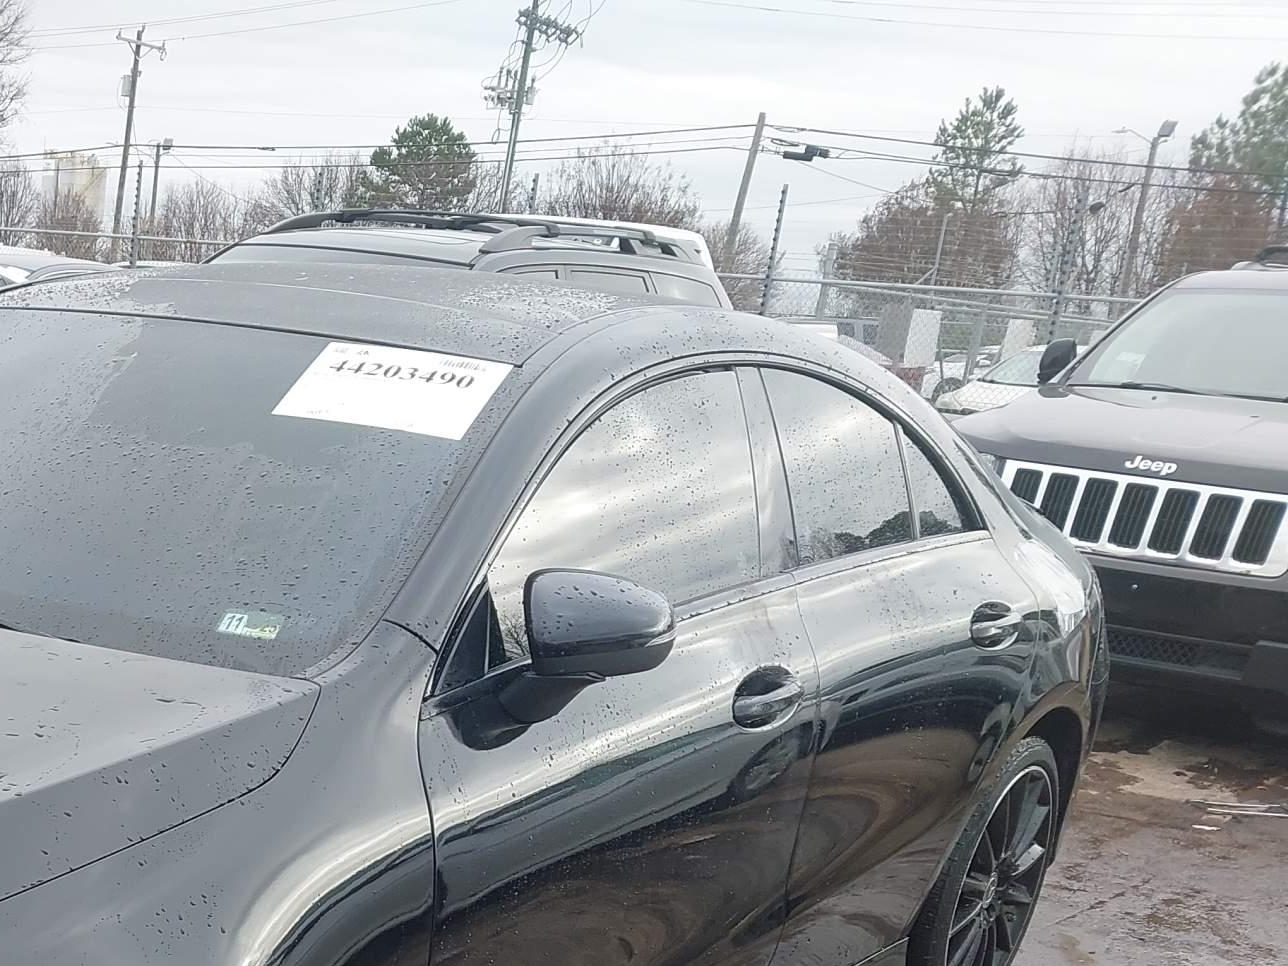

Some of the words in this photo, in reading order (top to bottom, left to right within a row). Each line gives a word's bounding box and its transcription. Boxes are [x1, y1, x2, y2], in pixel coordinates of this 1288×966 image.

[329, 359, 476, 389] 44203490
[1124, 455, 1178, 476] Jeep
[224, 614, 245, 632] 11
